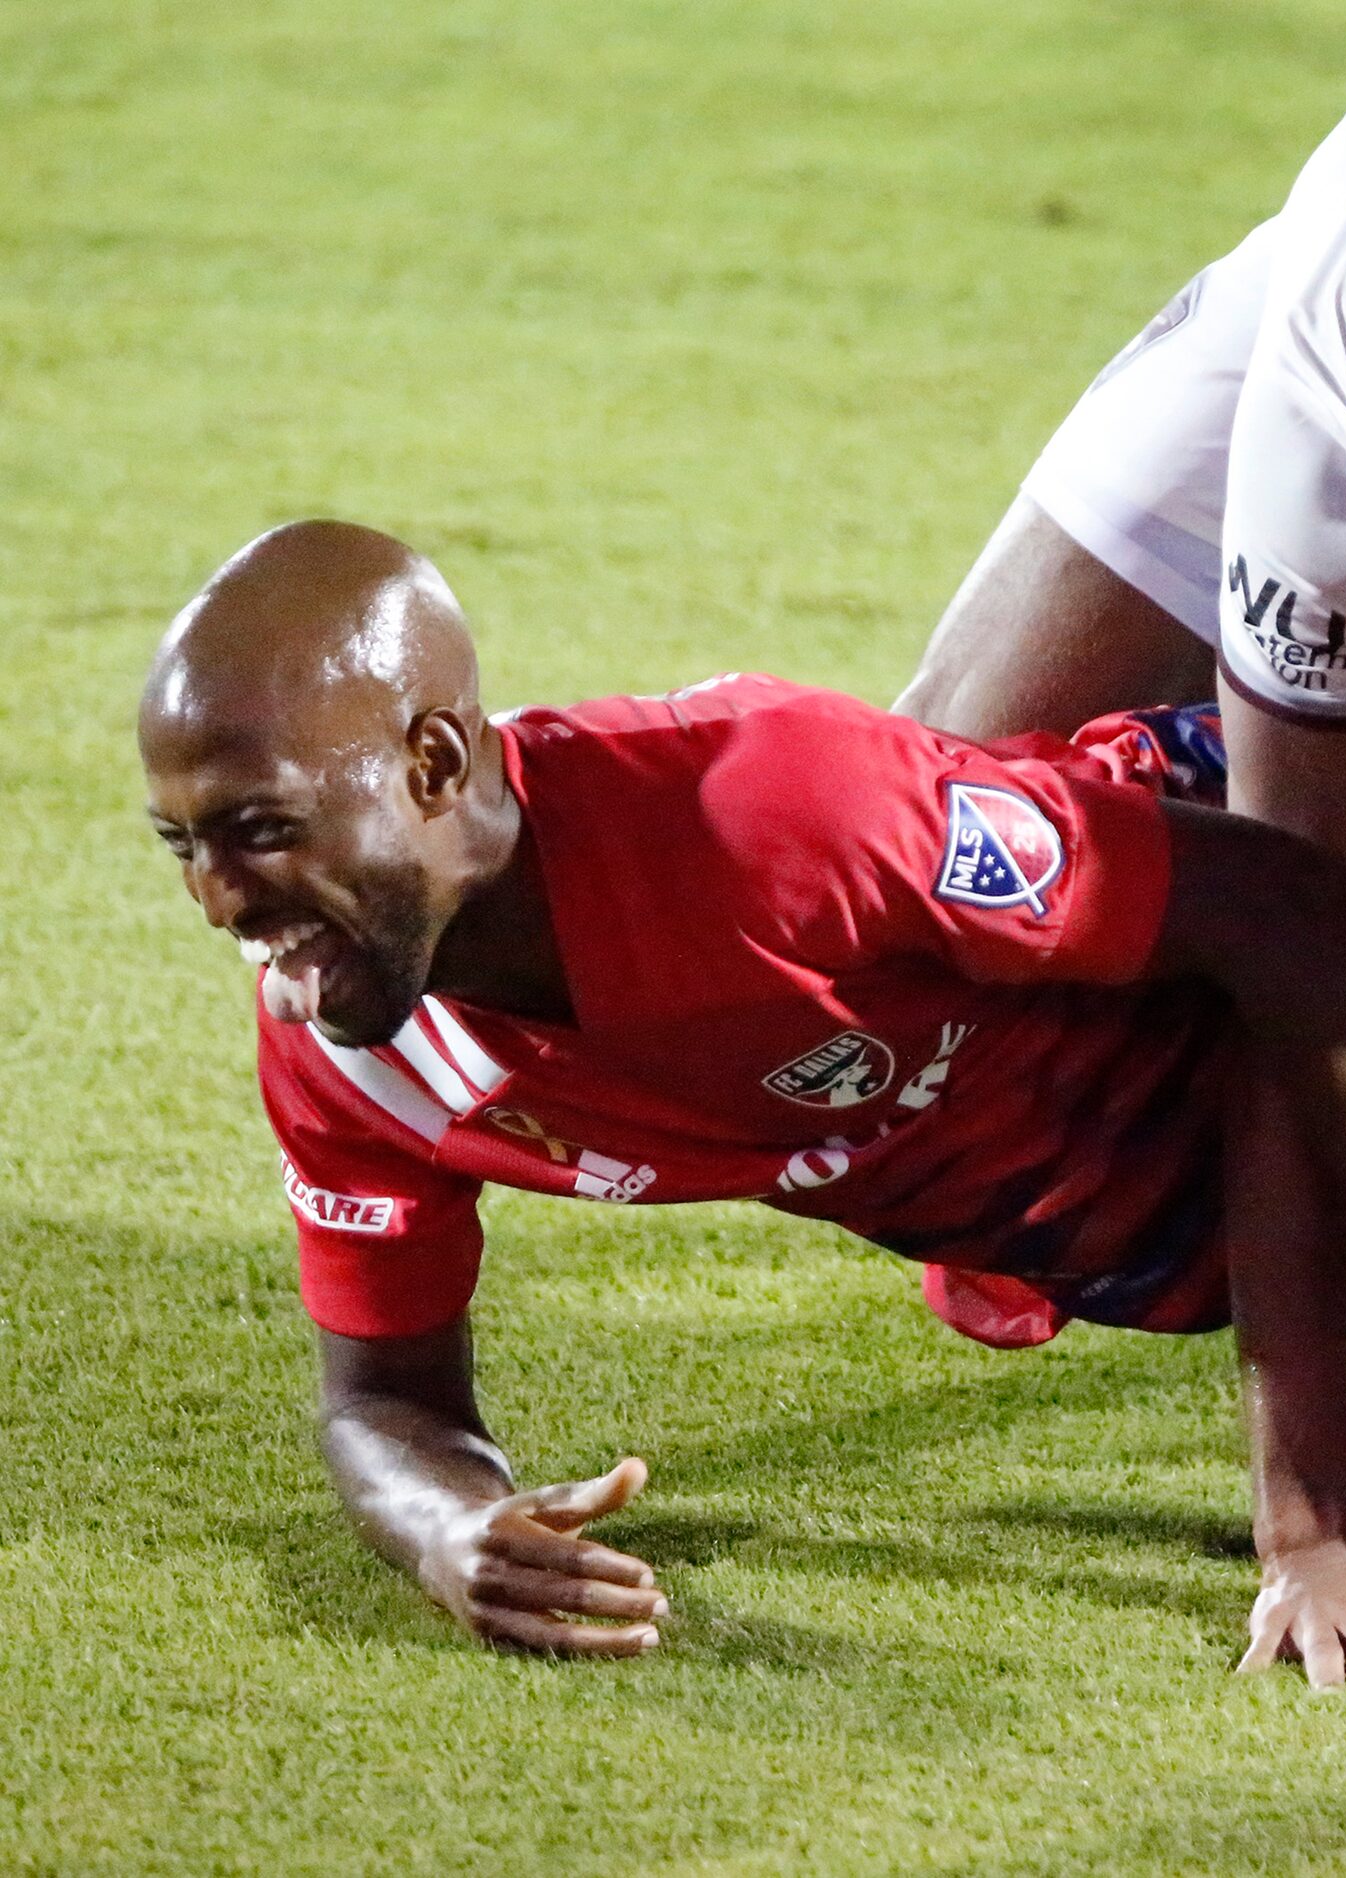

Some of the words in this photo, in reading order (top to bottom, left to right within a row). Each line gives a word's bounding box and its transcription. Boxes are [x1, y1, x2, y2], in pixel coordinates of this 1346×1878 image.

[950, 827, 984, 890] MLS
[772, 1072, 803, 1094] FC
[793, 1037, 863, 1079] DALLAS
